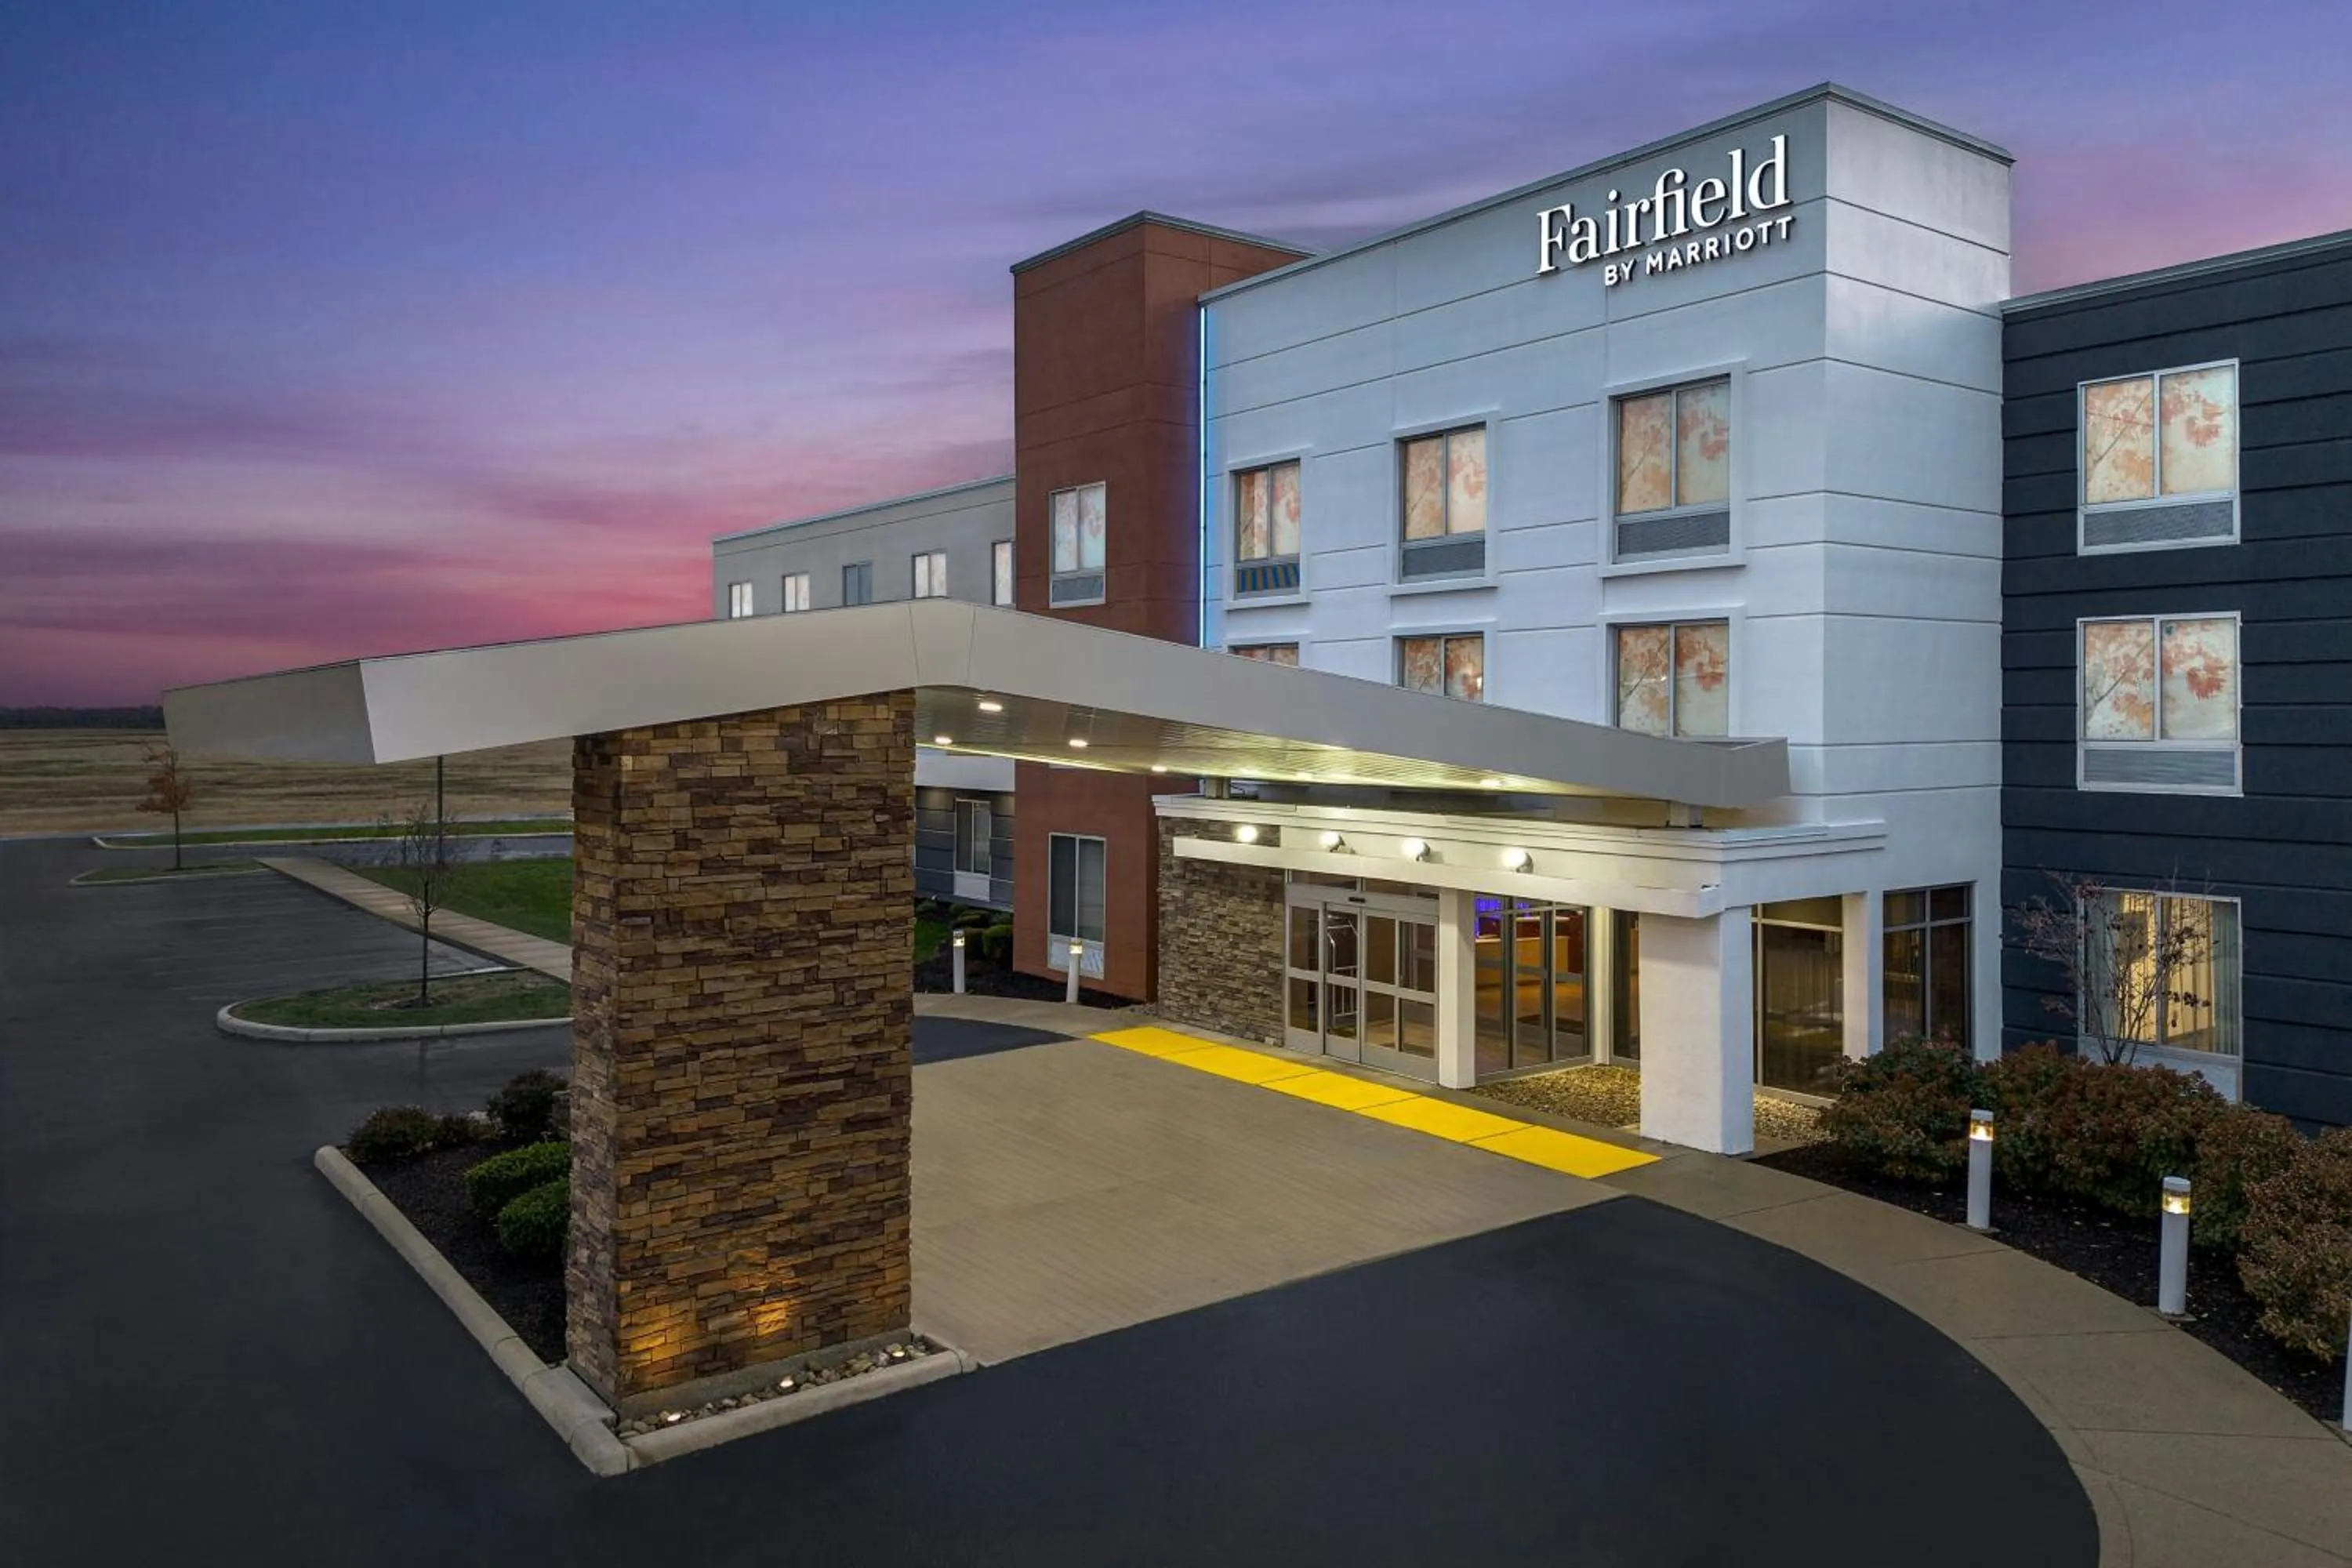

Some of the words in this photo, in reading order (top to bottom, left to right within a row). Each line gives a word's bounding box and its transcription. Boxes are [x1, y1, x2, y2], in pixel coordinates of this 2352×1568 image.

[1536, 133, 1791, 274] Fairfield
[1605, 260, 1634, 286] BY
[1646, 216, 1793, 274] MARRIOTT
